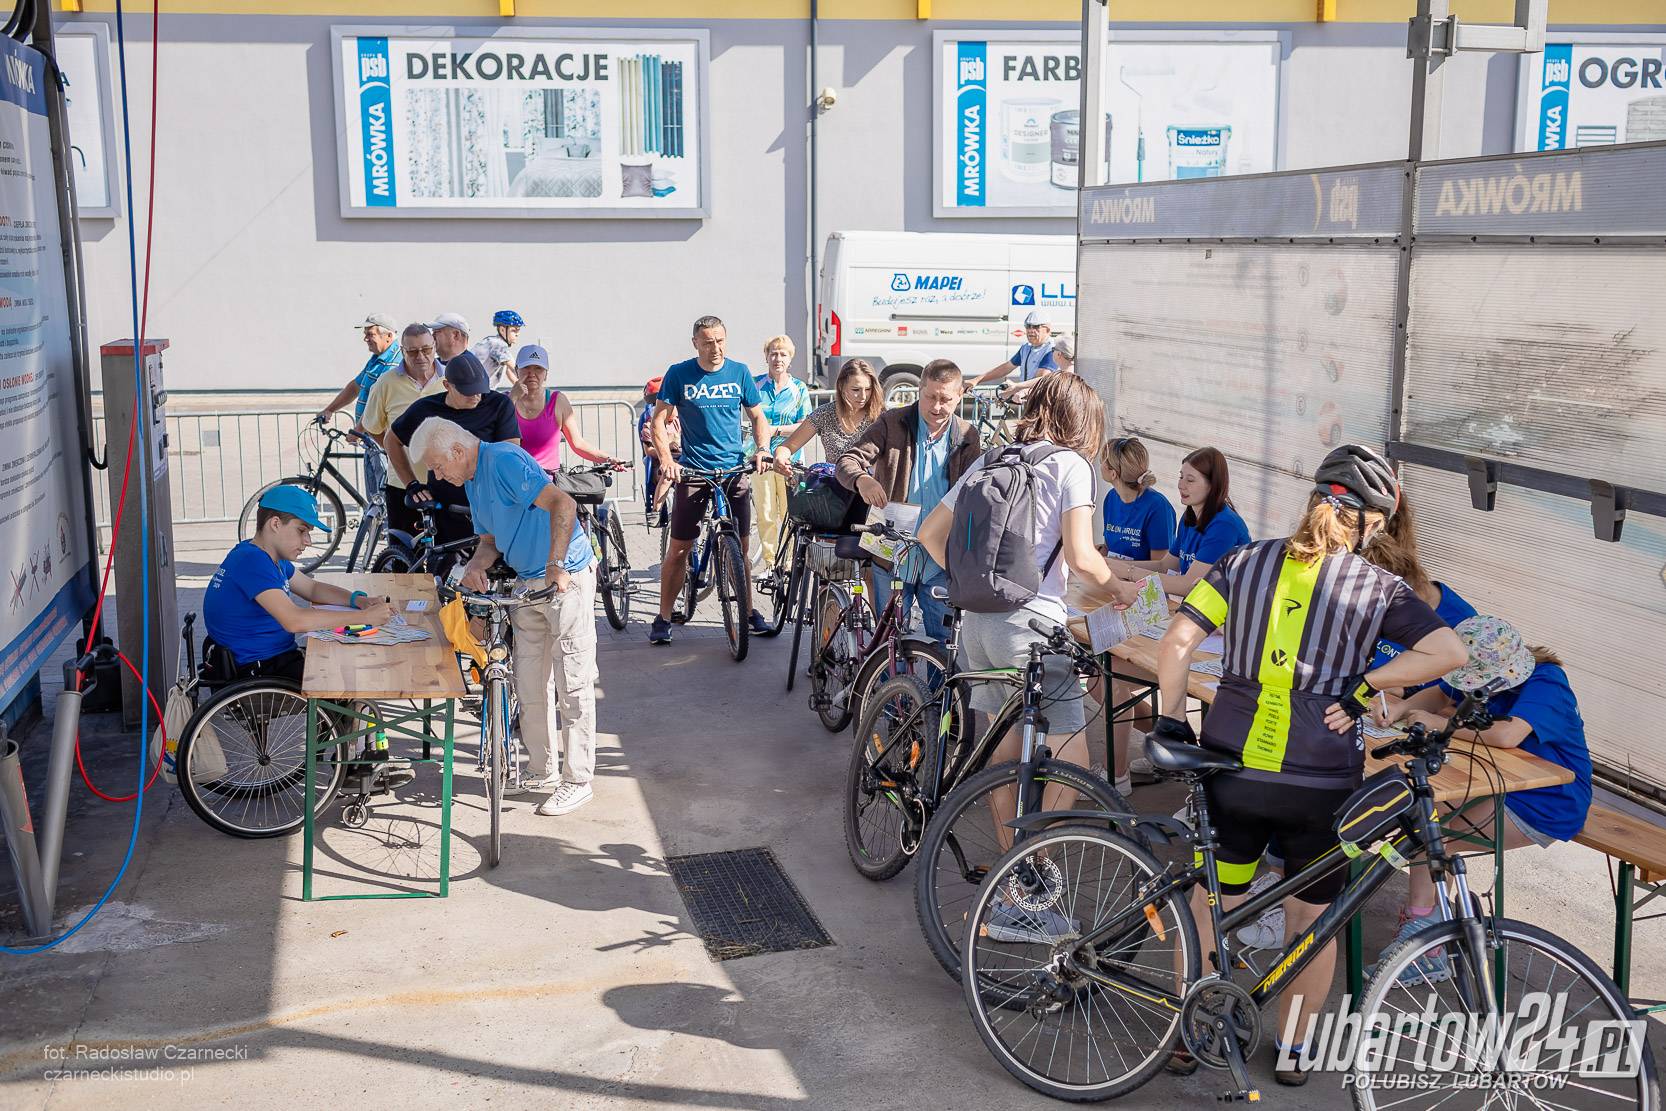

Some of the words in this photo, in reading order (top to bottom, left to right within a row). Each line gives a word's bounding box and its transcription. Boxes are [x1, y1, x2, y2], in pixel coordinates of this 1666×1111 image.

[406, 52, 609, 81] DEKORACJE
[1002, 55, 1082, 82] FARB
[366, 101, 390, 197] MRÓWKA
[962, 103, 981, 197] MRÓWKA
[914, 275, 963, 291] MAPEI
[683, 382, 742, 400] DAZED
[1263, 932, 1315, 993] MERIDA
